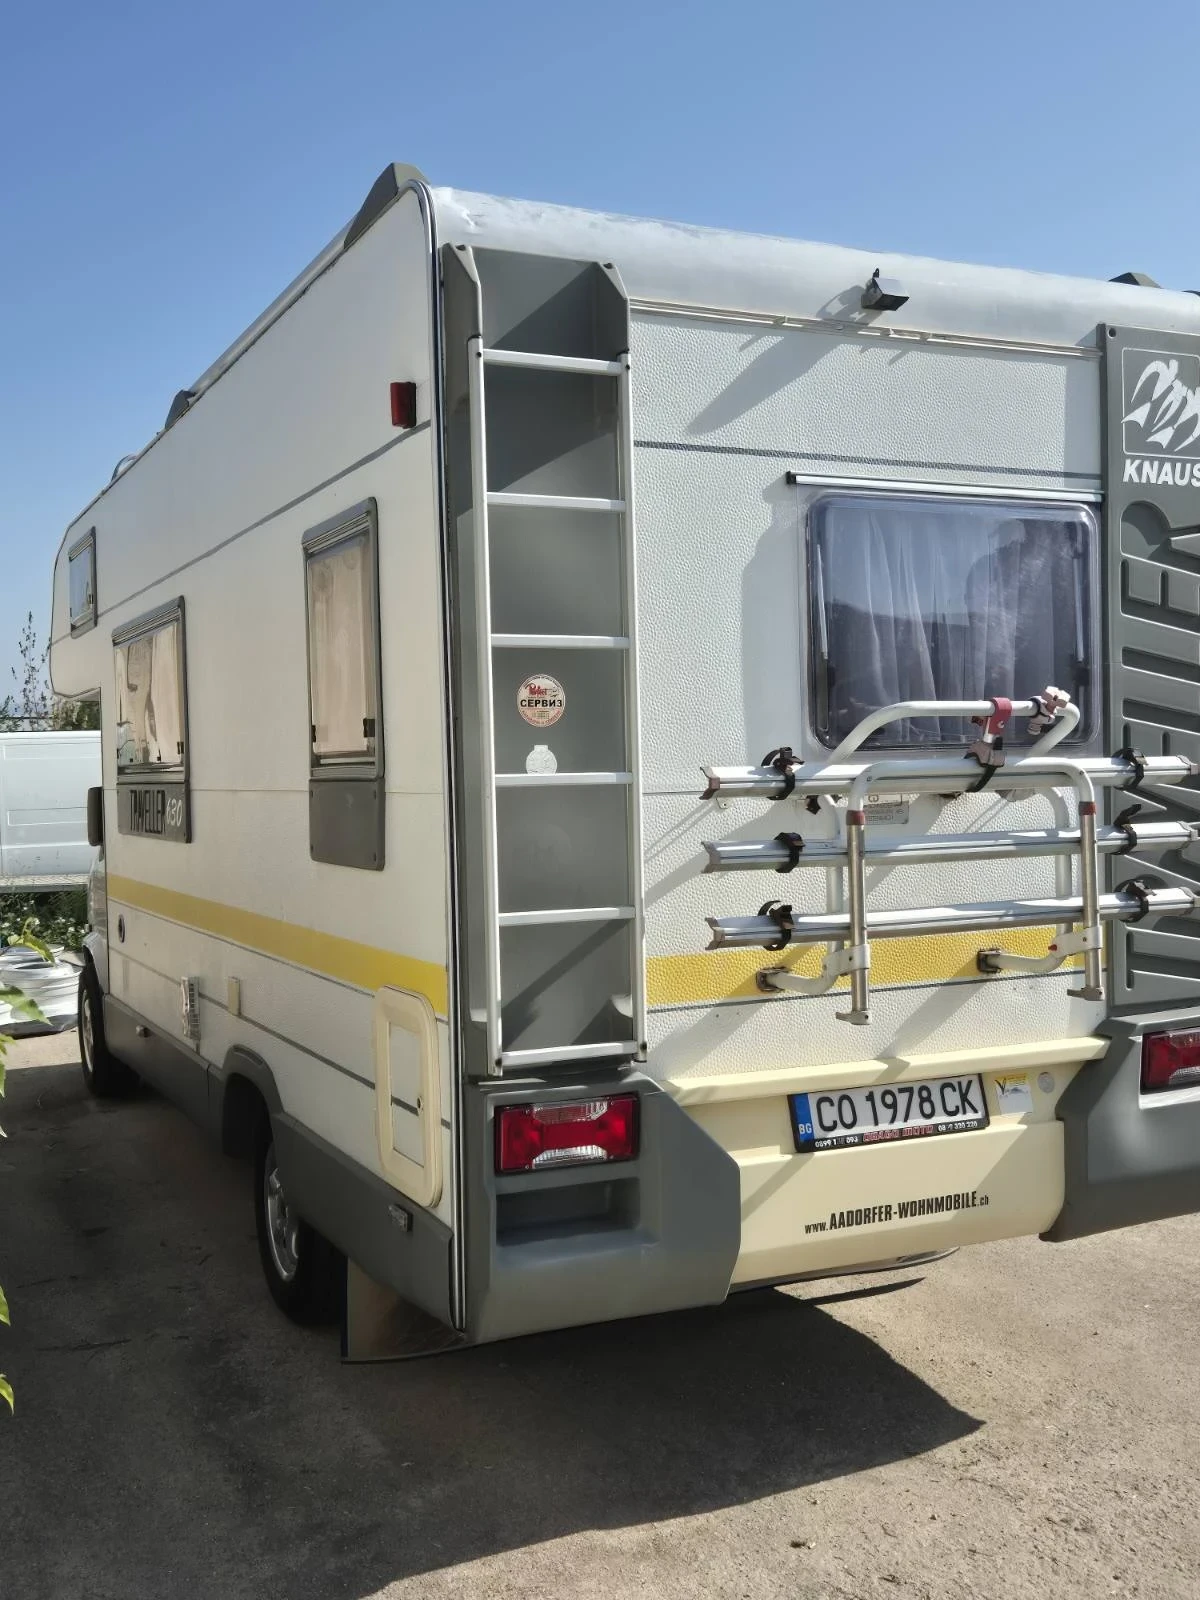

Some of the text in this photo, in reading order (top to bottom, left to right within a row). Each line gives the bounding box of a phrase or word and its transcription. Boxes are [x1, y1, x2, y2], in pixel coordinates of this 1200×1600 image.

[1122, 459, 1200, 487] KNAUS
[520, 699, 562, 708] СЕРВИЗ
[129, 789, 183, 834] TRAVELLER 630
[799, 1079, 980, 1135] BG CO 1978 CK
